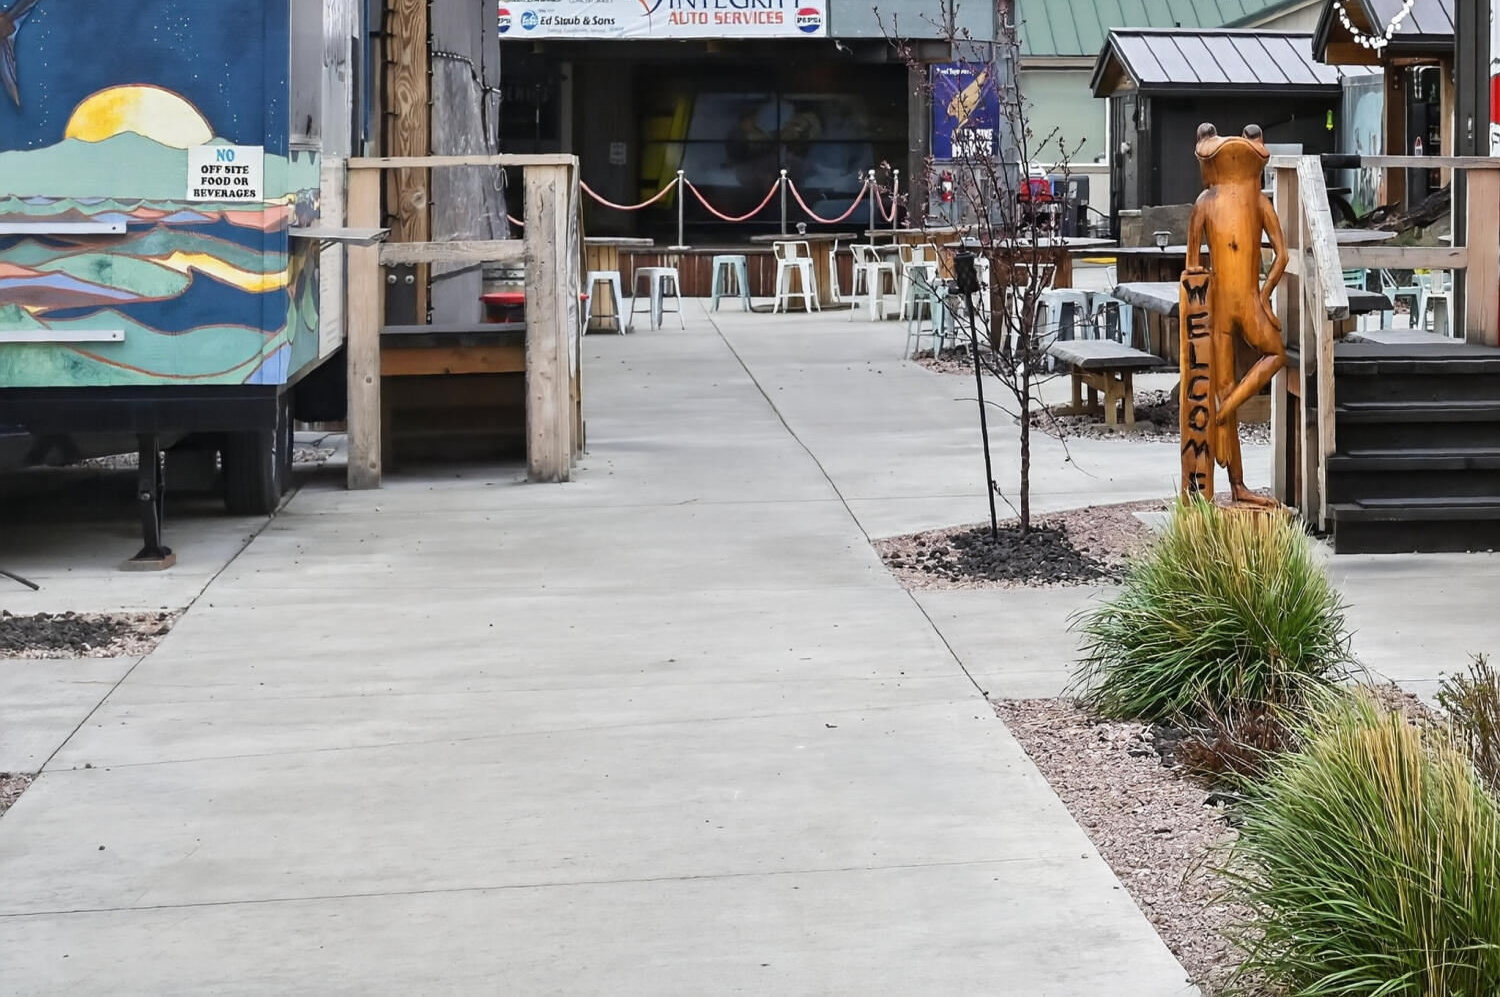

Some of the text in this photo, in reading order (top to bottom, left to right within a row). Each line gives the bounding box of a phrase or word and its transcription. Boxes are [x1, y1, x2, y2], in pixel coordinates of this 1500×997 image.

[540, 16, 552, 26] Ed
[554, 15, 581, 26] Staub
[583, 16, 591, 26] &
[591, 15, 616, 26] Sons
[668, 11, 784, 25] AUTO SERVICES
[216, 148, 235, 162] NO
[201, 165, 249, 174] OFF SITE
[200, 177, 249, 186] FOOD OR
[193, 189, 256, 198] BEVERAGES
[1182, 277, 1210, 493] WELCOME
